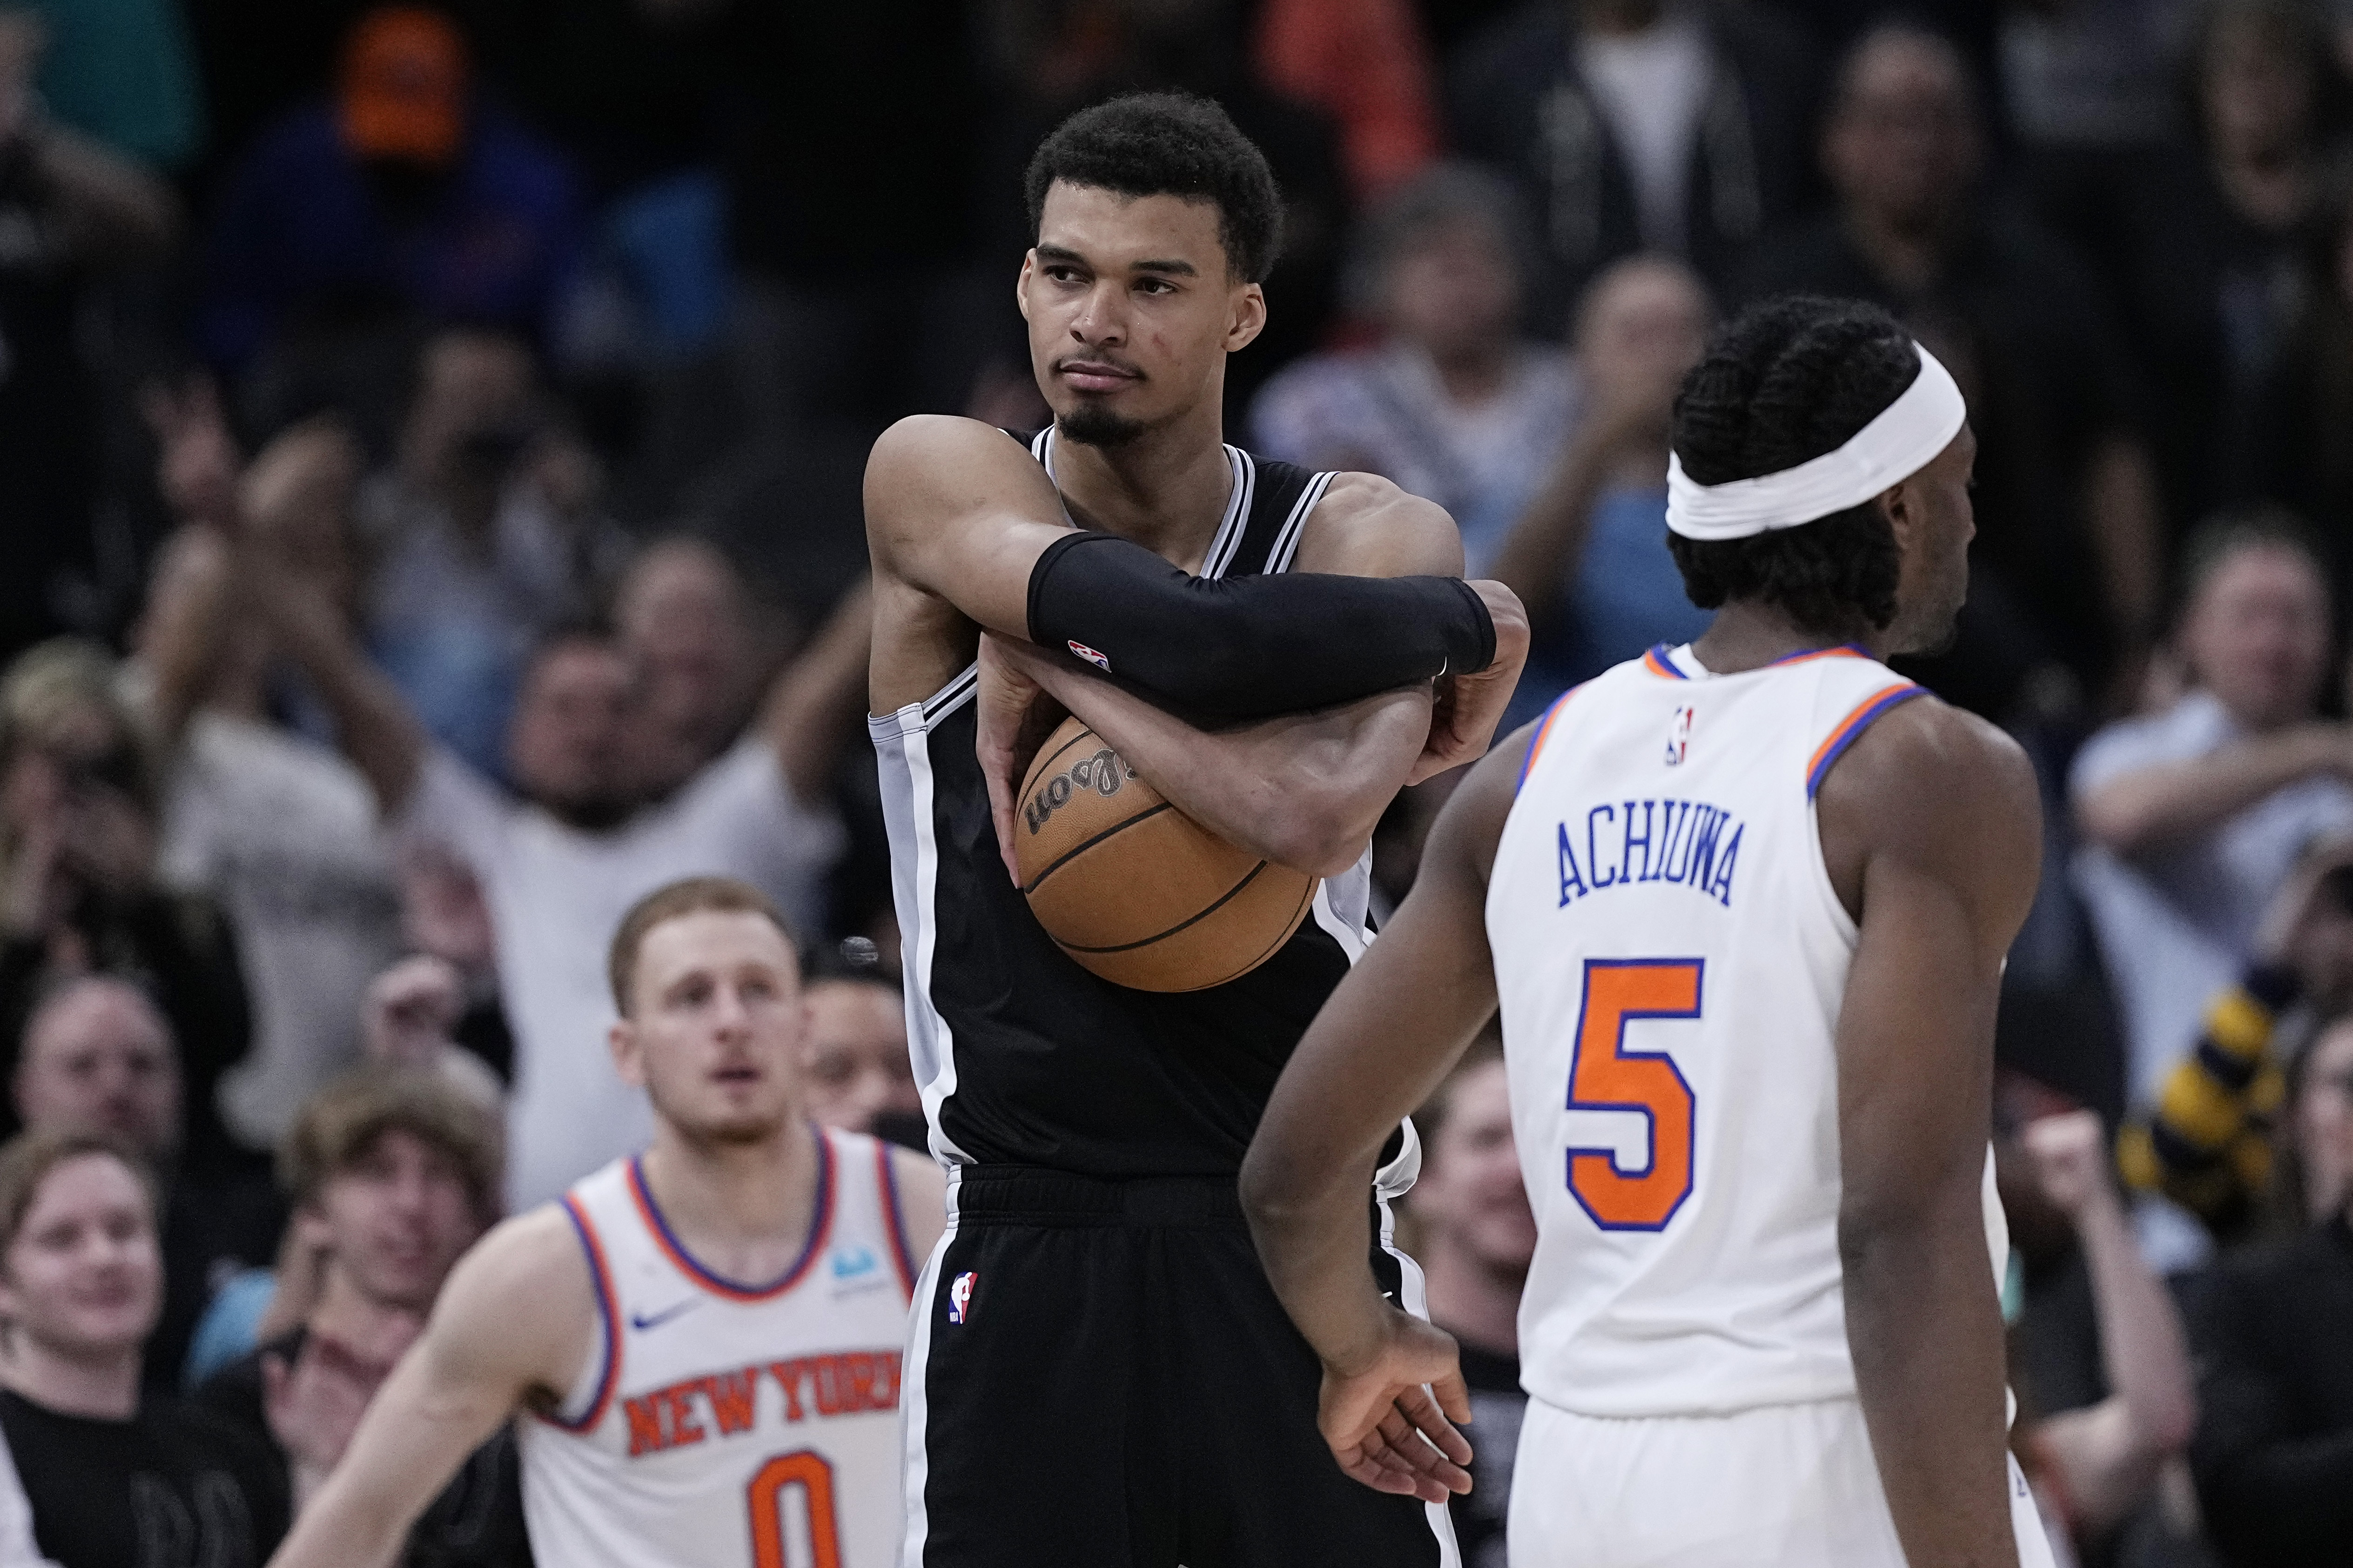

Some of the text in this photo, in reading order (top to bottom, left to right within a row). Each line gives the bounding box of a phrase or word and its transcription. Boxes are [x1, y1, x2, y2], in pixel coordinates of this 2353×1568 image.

[1024, 748, 1137, 835] lson
[1558, 799, 1745, 907] ACHIUWA
[1566, 958, 1705, 1233] 5
[949, 1312, 959, 1322] NBA
[624, 1366, 759, 1458] NEW
[747, 1449, 842, 1568] 0
